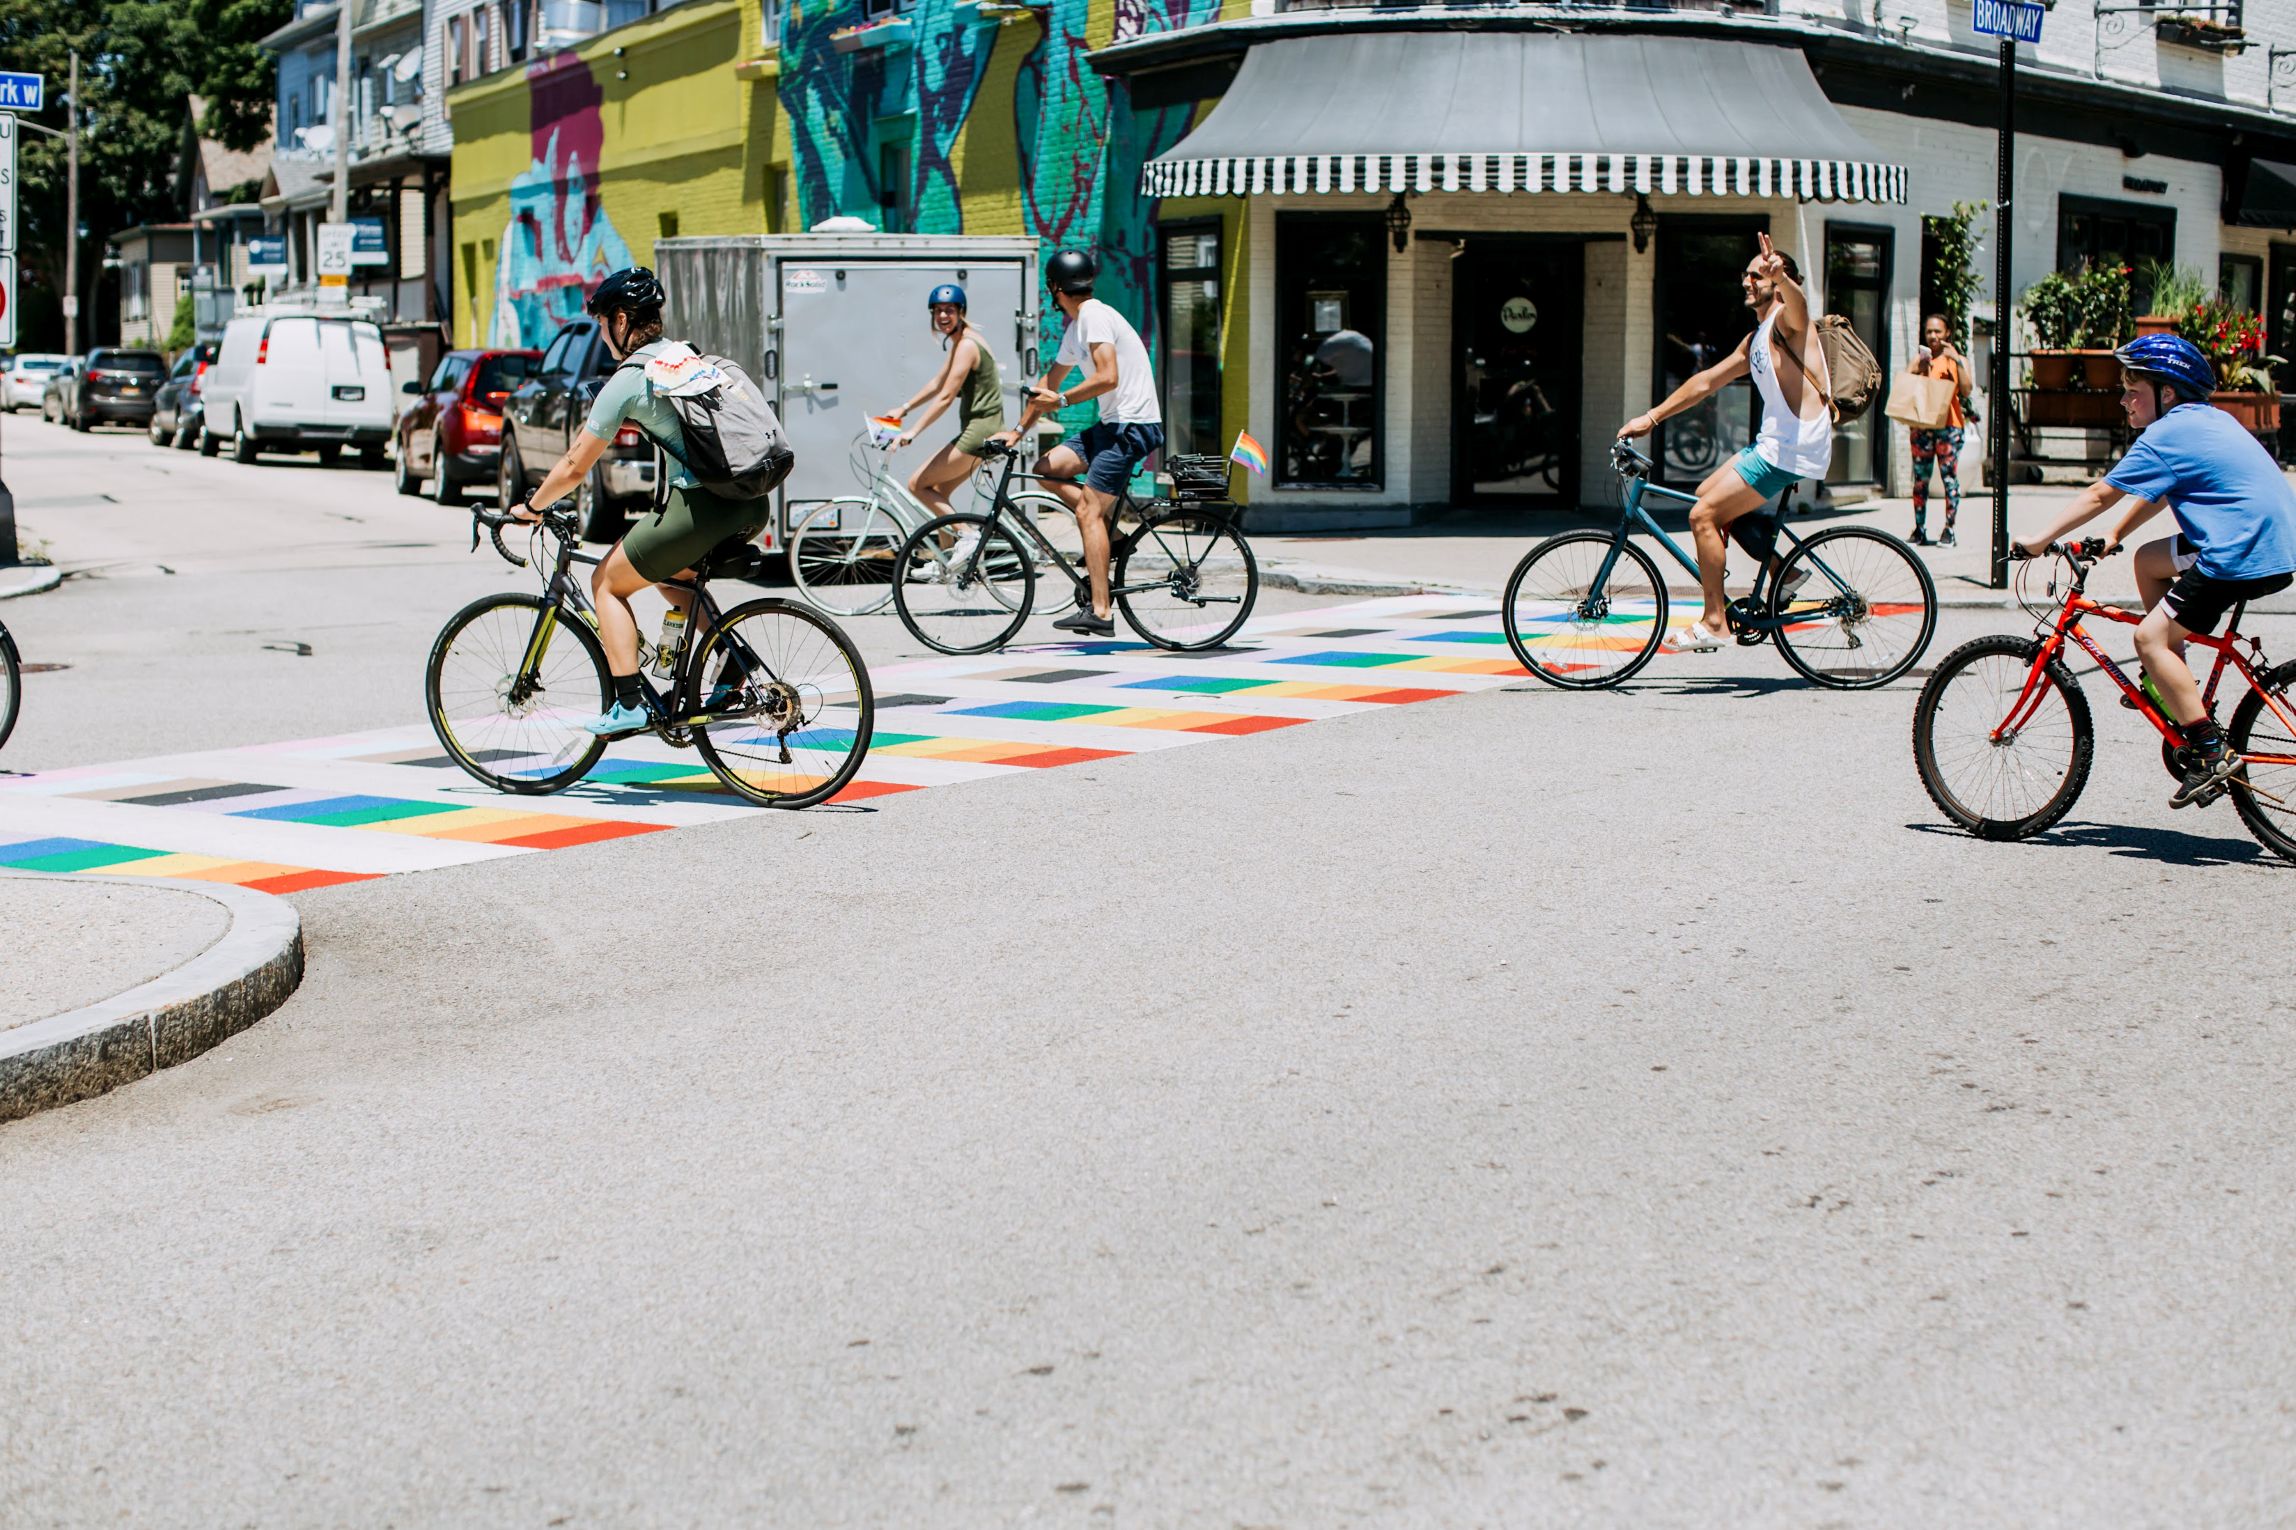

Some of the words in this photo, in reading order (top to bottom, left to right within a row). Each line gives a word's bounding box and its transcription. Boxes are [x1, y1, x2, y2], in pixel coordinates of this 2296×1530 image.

[1976, 0, 2041, 39] BROADWAY
[323, 251, 346, 268] 25
[2167, 357, 2192, 370] TREK
